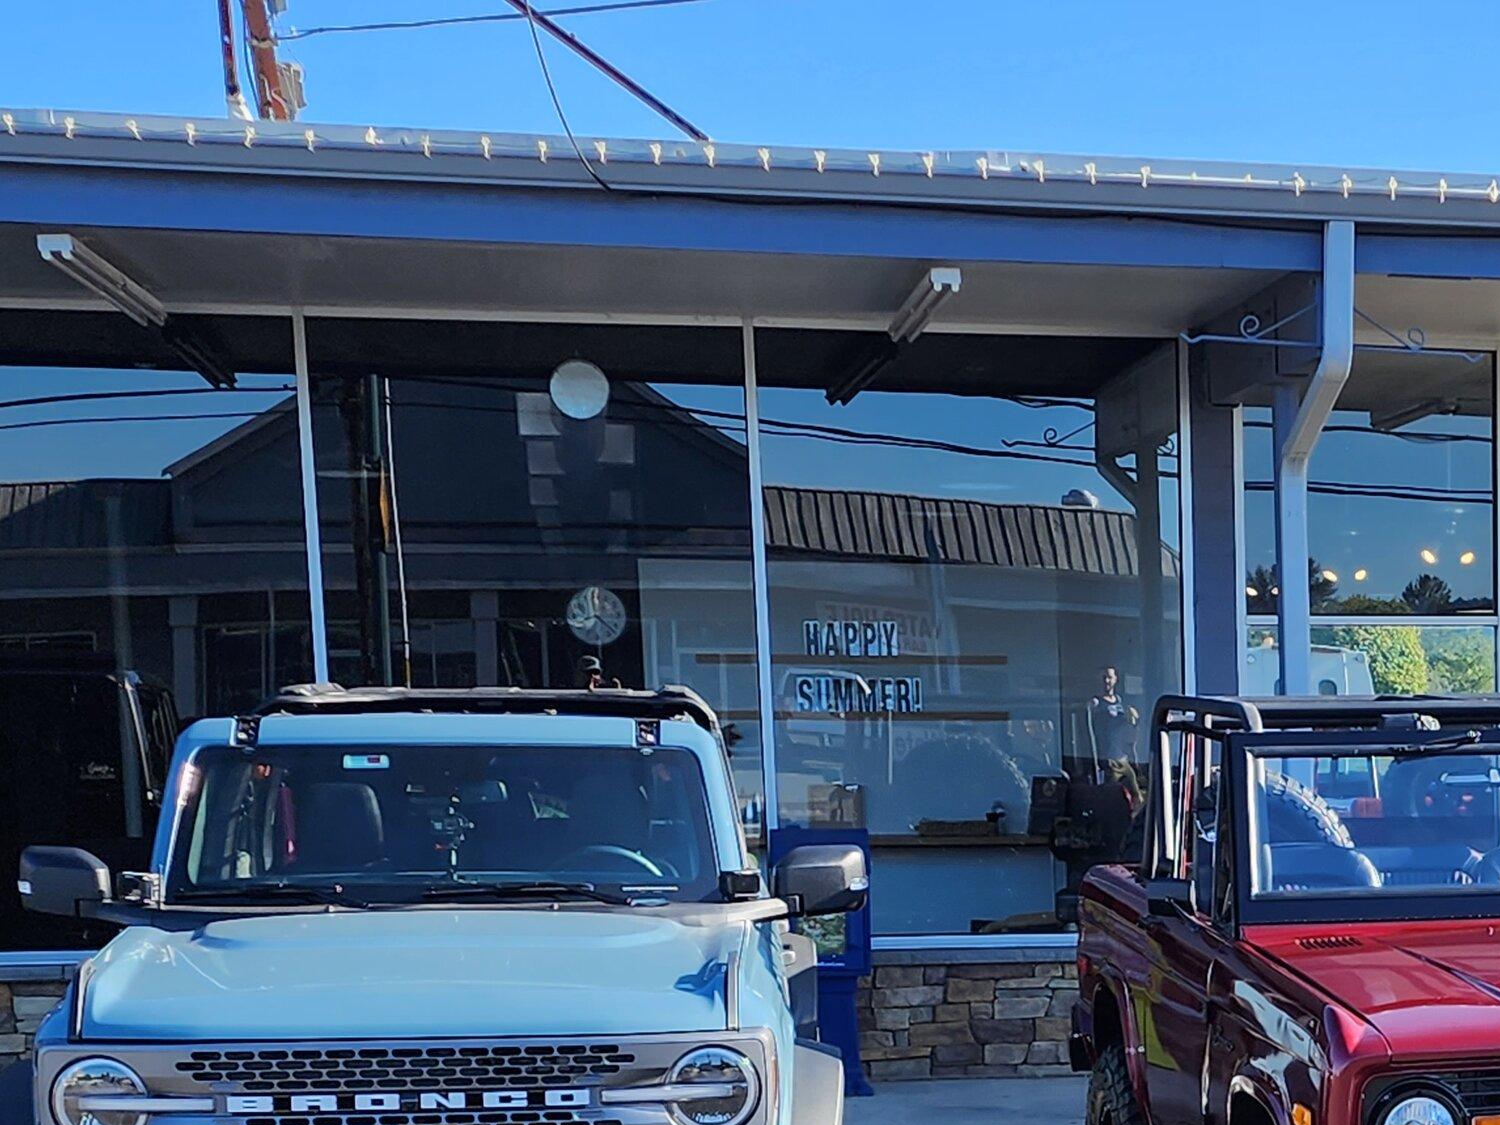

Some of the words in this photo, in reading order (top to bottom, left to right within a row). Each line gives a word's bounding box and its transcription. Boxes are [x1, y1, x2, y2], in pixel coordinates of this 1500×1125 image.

[804, 620, 897, 656] HAPPY
[797, 677, 922, 713] SUMMER!
[226, 1089, 590, 1113] BRONCO
